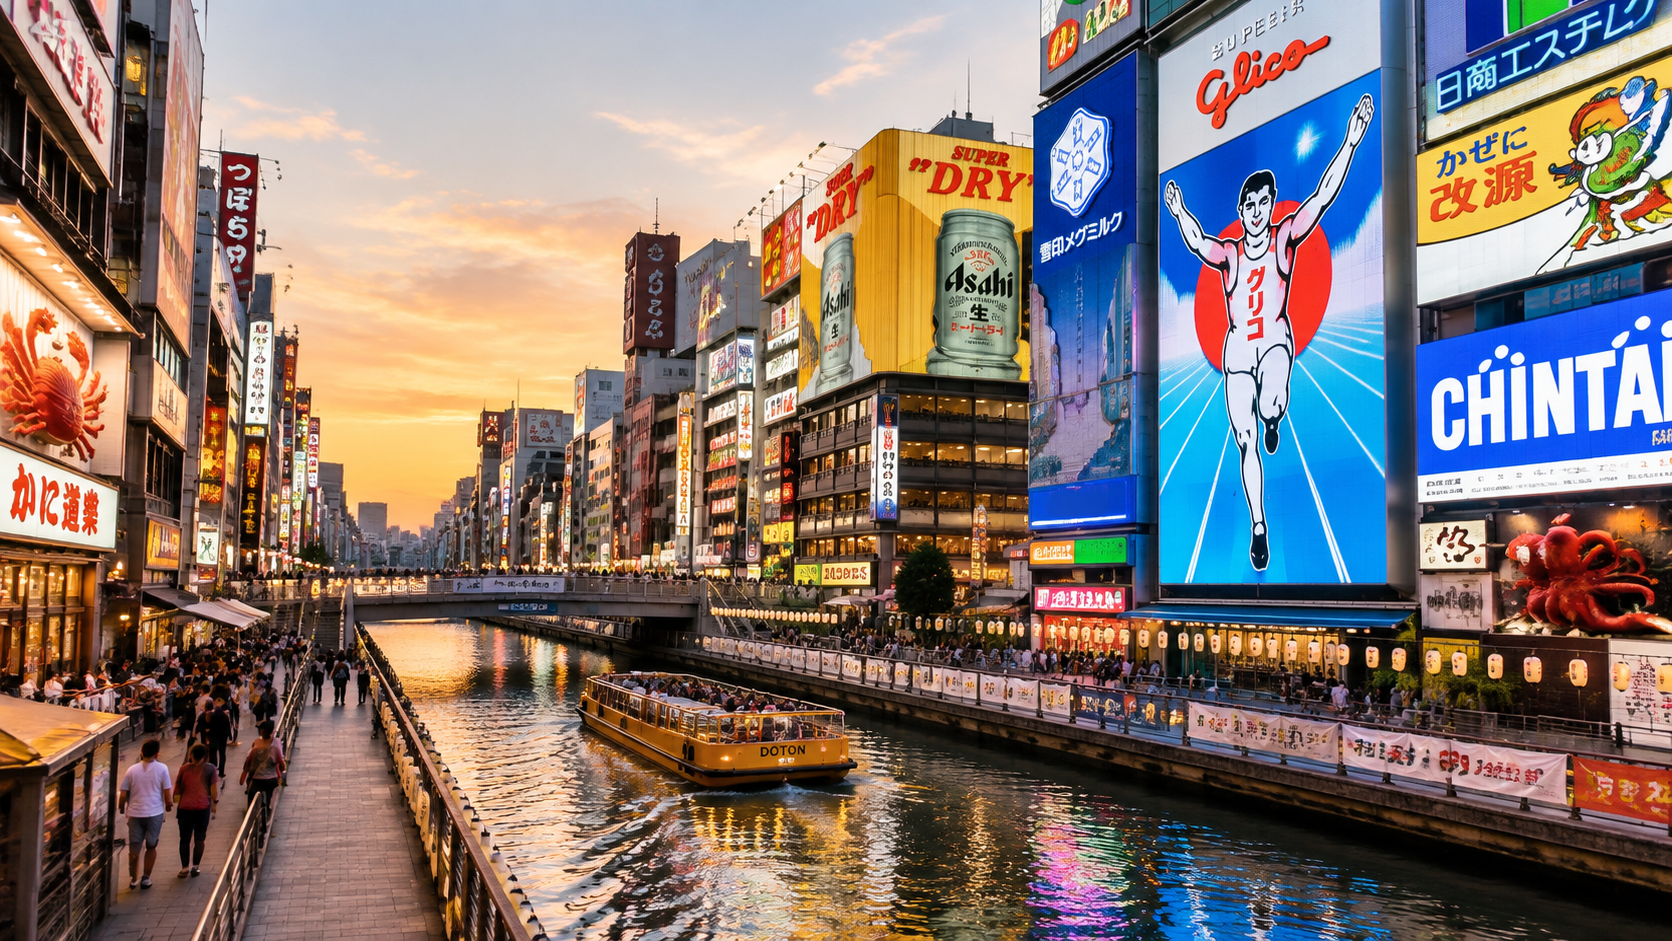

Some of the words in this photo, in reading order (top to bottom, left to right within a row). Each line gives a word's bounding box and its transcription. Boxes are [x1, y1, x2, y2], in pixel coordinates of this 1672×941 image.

[1196, 35, 1331, 129] Glico
[951, 145, 1010, 167] SUPER
[1436, 126, 1528, 179] かぜに
[1430, 150, 1538, 223] 改源
[945, 262, 1013, 299] Asahi
[822, 281, 850, 321] Asahi
[969, 303, 989, 323] 生
[1247, 265, 1266, 341] グリコ
[760, 745, 806, 757] DOTON
